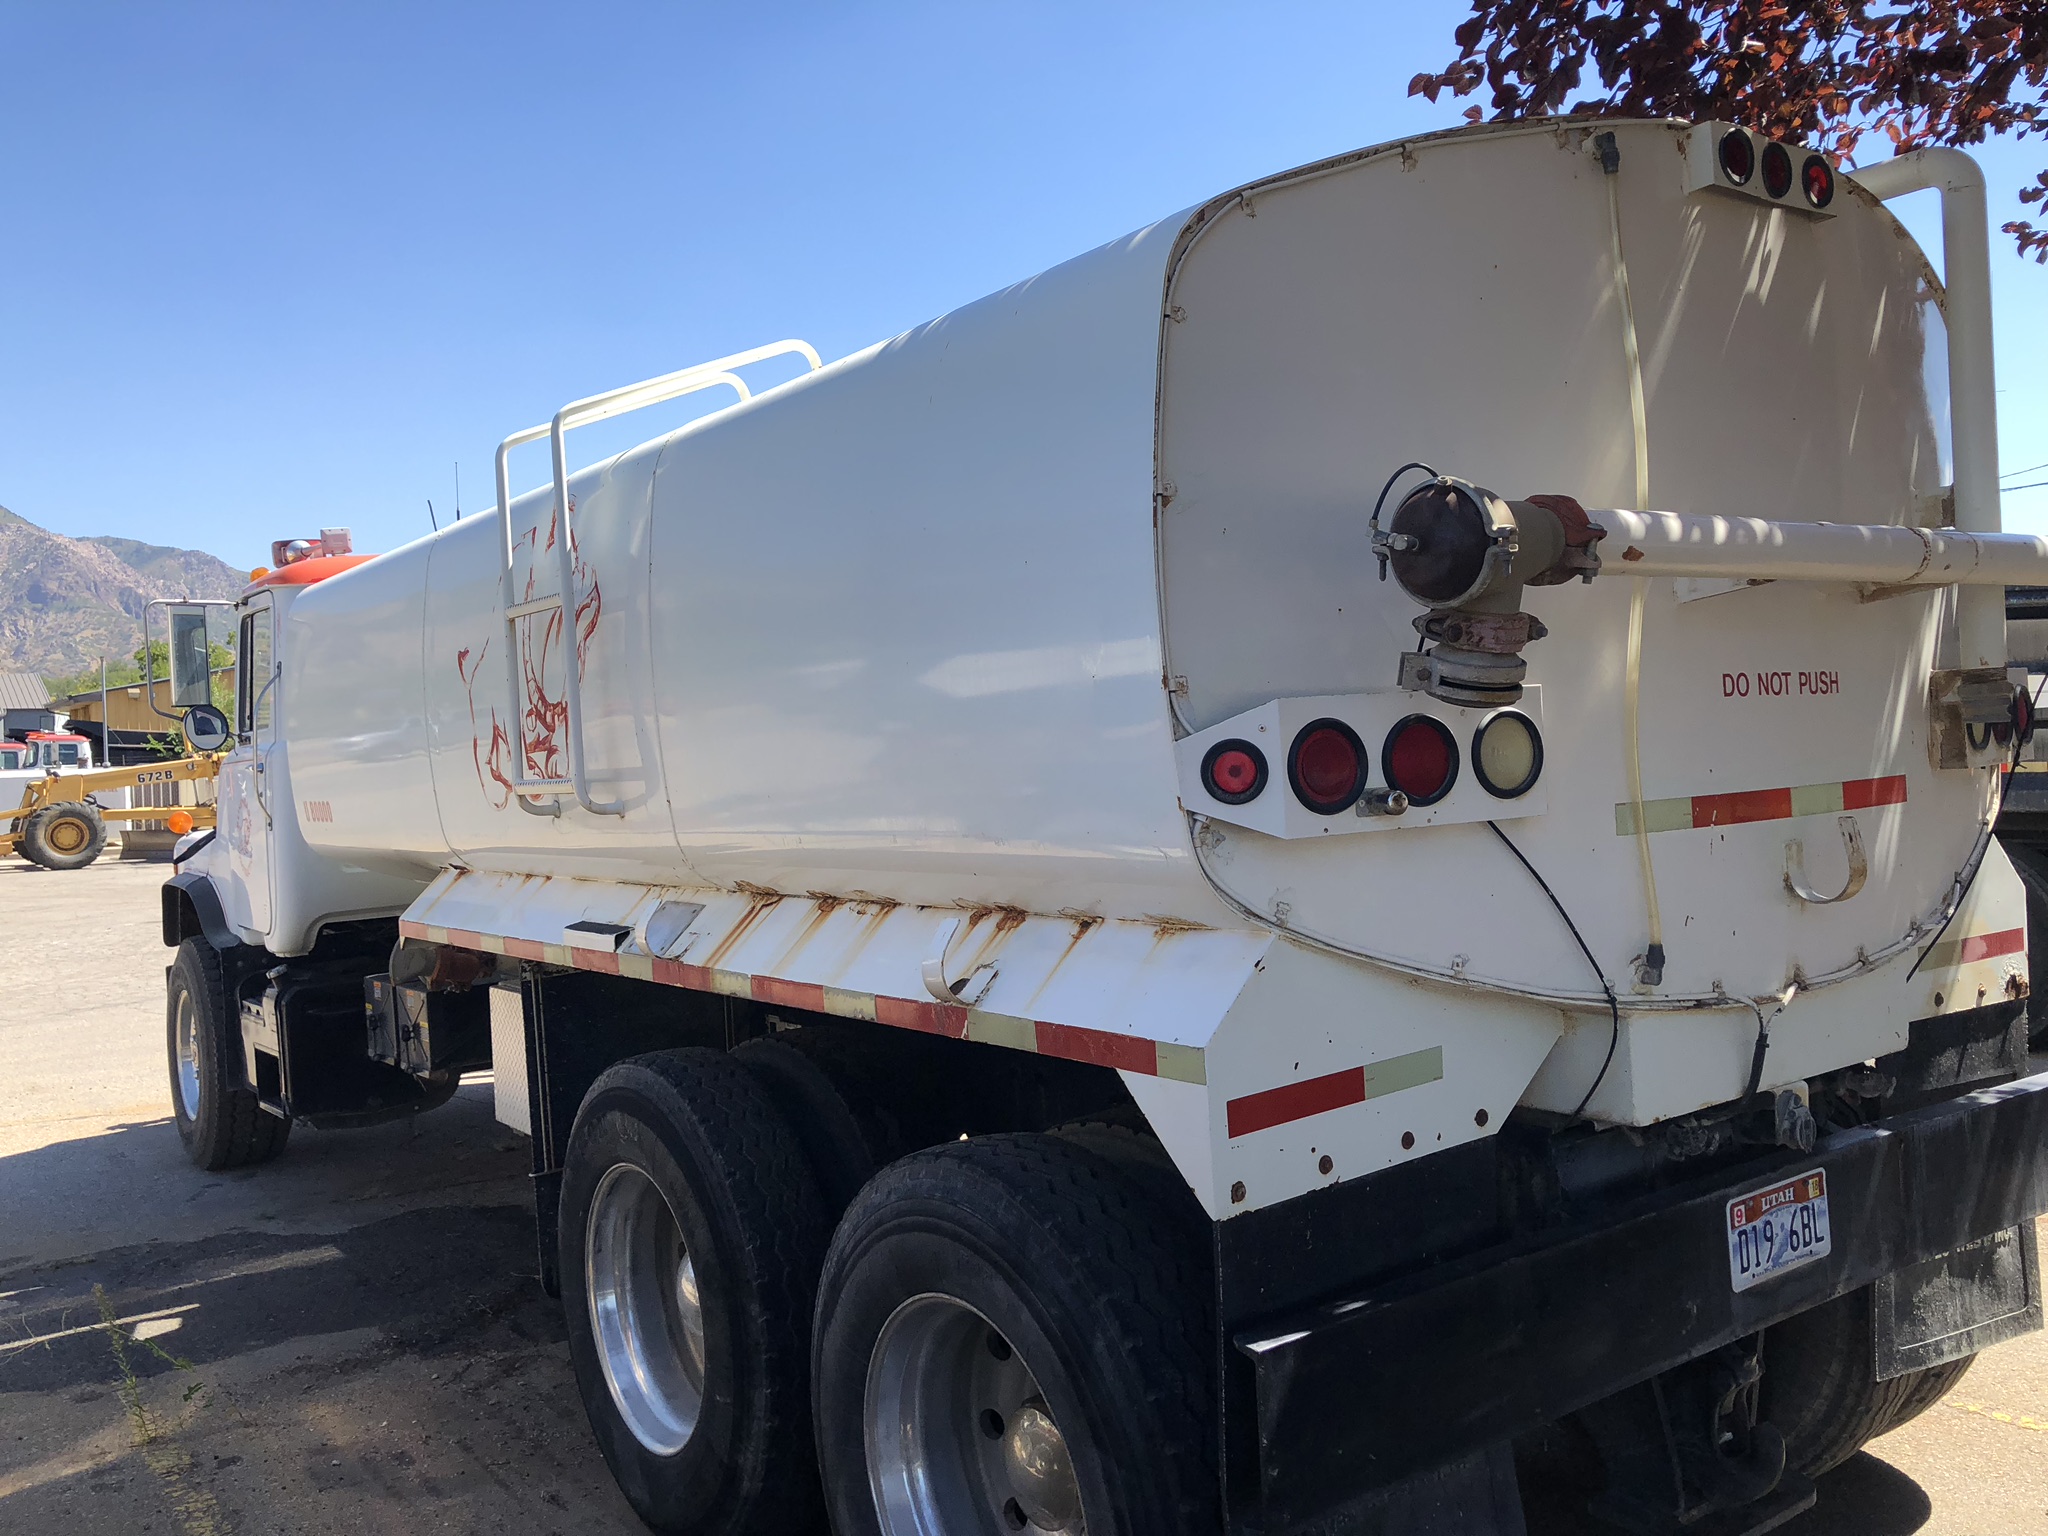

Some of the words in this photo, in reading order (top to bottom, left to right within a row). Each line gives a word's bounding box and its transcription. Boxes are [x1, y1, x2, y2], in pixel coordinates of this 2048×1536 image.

[1722, 672, 1750, 697] DO
[1757, 671, 1791, 696] NOT
[1798, 670, 1840, 695] PUSH
[137, 769, 174, 783] 672B
[1735, 1208, 1743, 1224] 9
[1761, 1186, 1795, 1211] UTAH
[1789, 1202, 1825, 1253] 6BL
